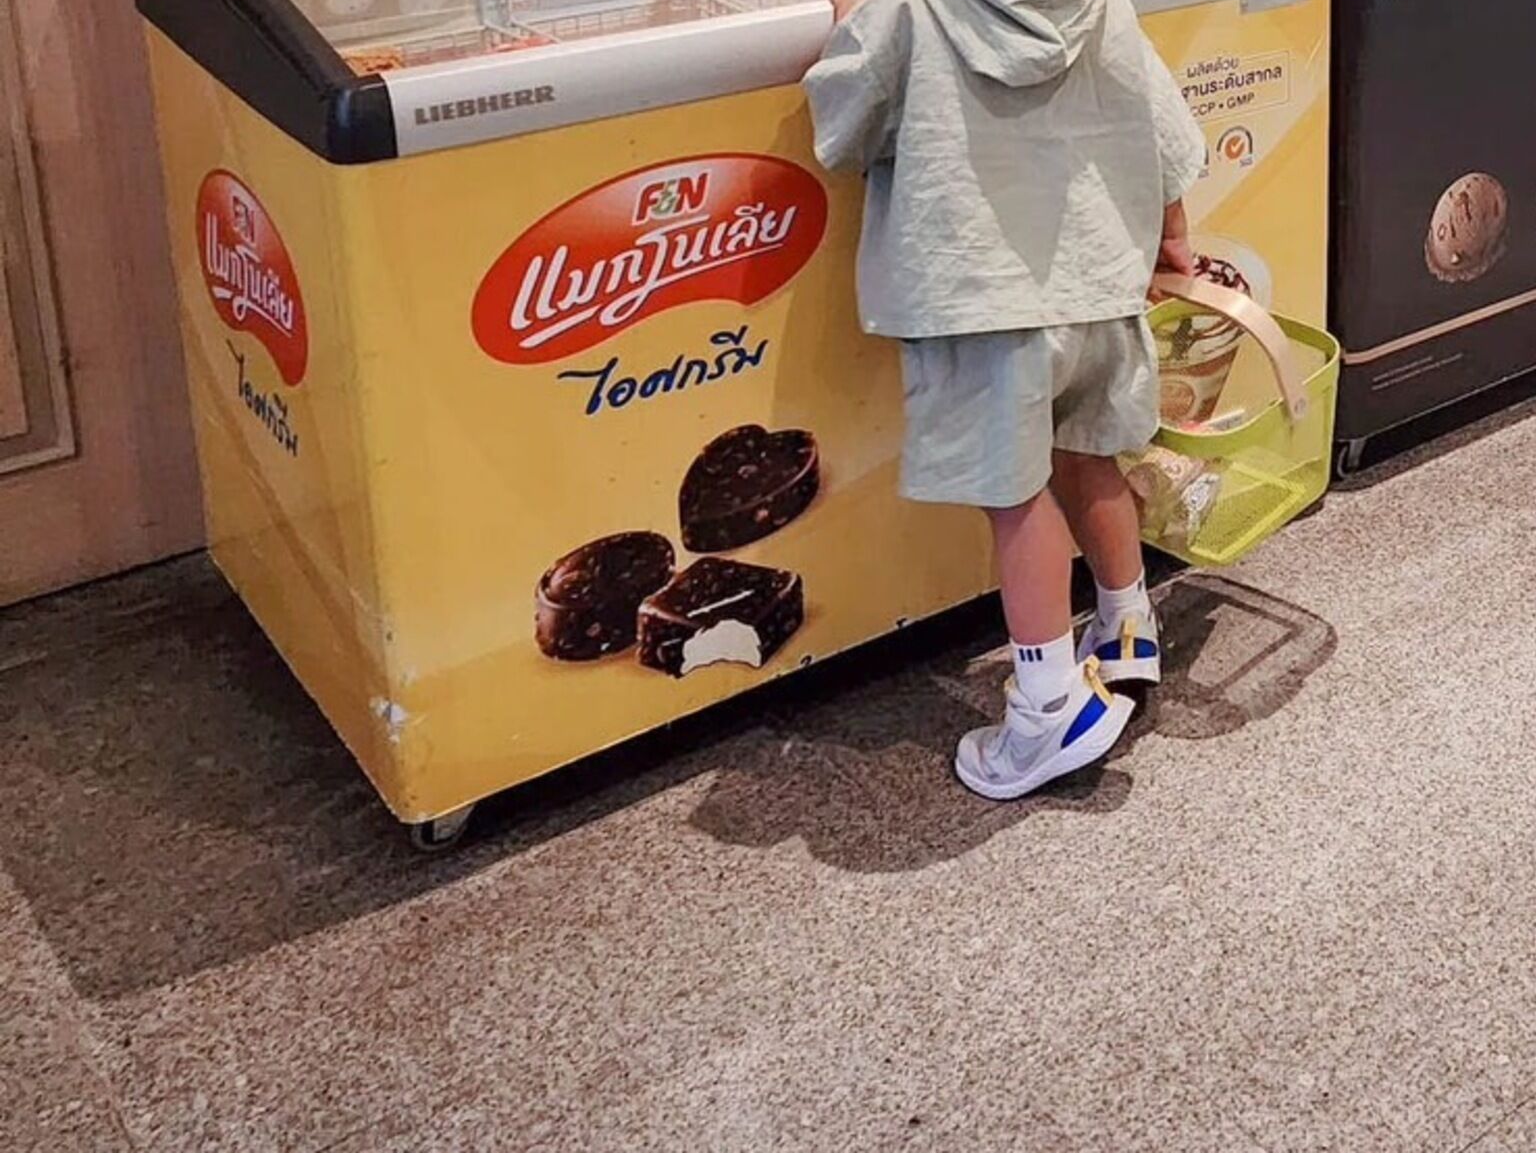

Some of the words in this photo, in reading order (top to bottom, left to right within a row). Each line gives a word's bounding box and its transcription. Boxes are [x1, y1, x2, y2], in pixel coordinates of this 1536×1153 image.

[414, 85, 556, 126] LIEBHERR
[1181, 65, 1283, 101] ฐานระดับสากล
[1226, 91, 1255, 109] GMP
[635, 170, 711, 226] F&N
[509, 203, 798, 342] แมกโนเลีย
[557, 325, 769, 415] ไอศกรีม
